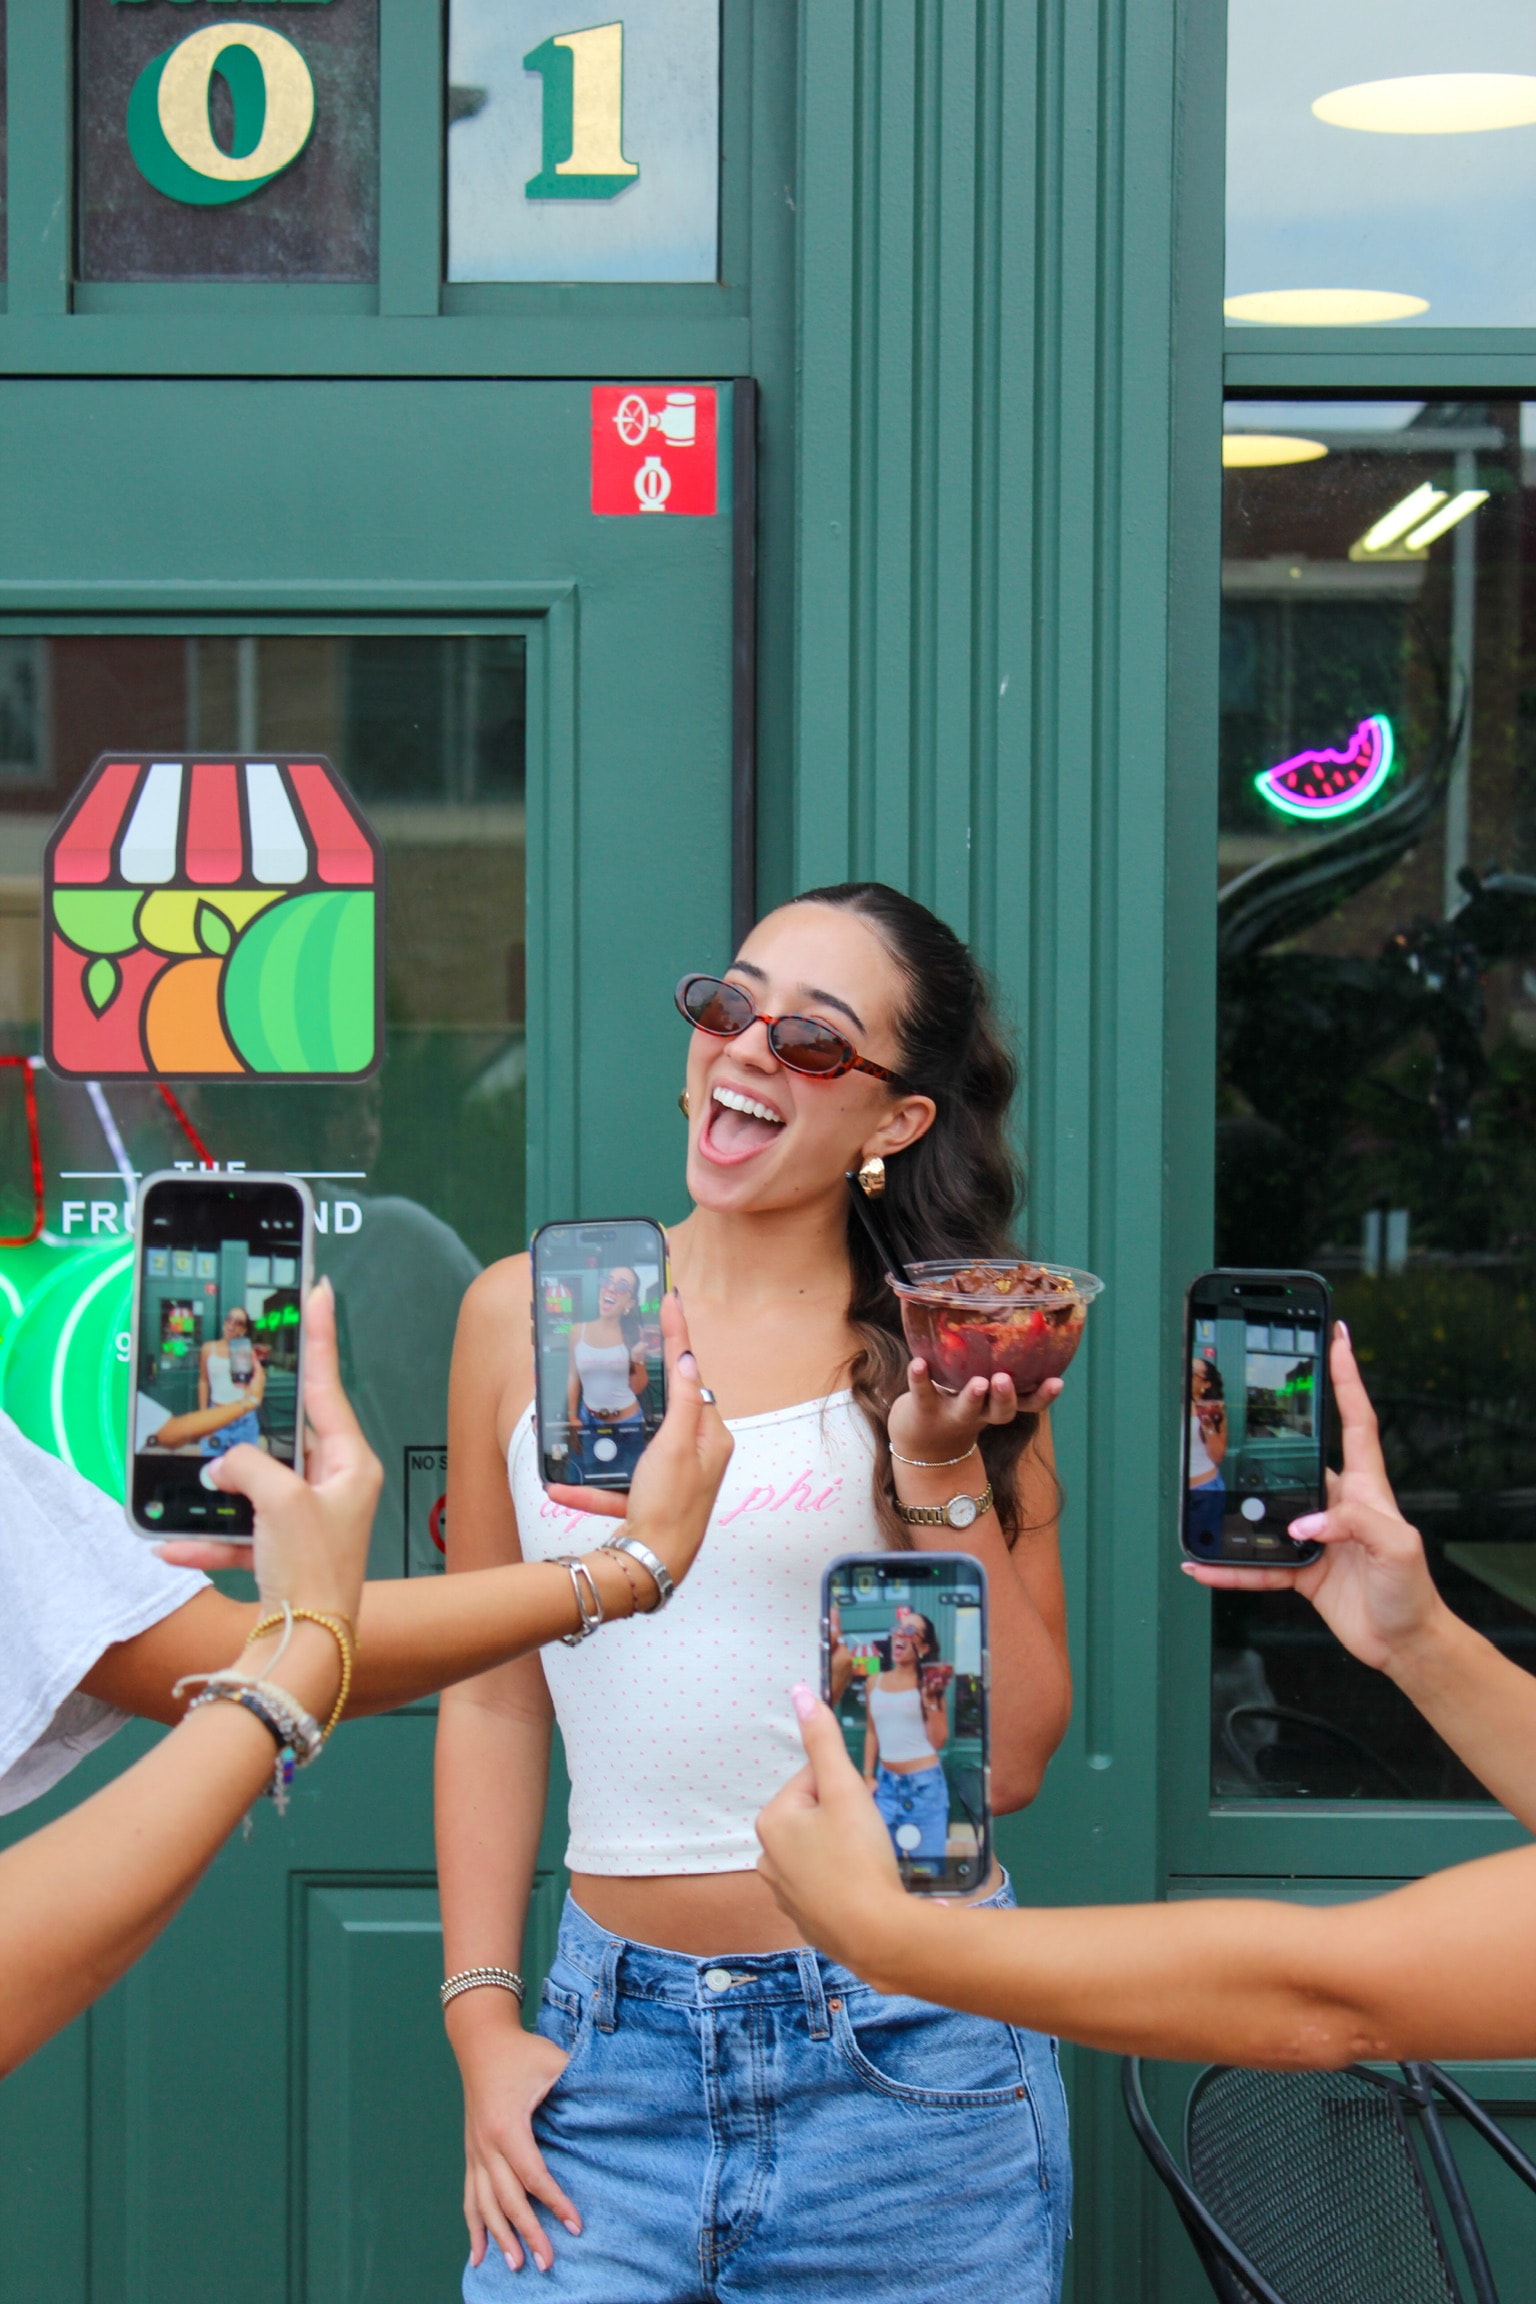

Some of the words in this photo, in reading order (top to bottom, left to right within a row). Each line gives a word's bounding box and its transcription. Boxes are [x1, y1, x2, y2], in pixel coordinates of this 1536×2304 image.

[129, 22, 315, 204] 0
[524, 21, 639, 198] 1
[411, 1456, 434, 1470] NO
[718, 1469, 843, 1526] phi
